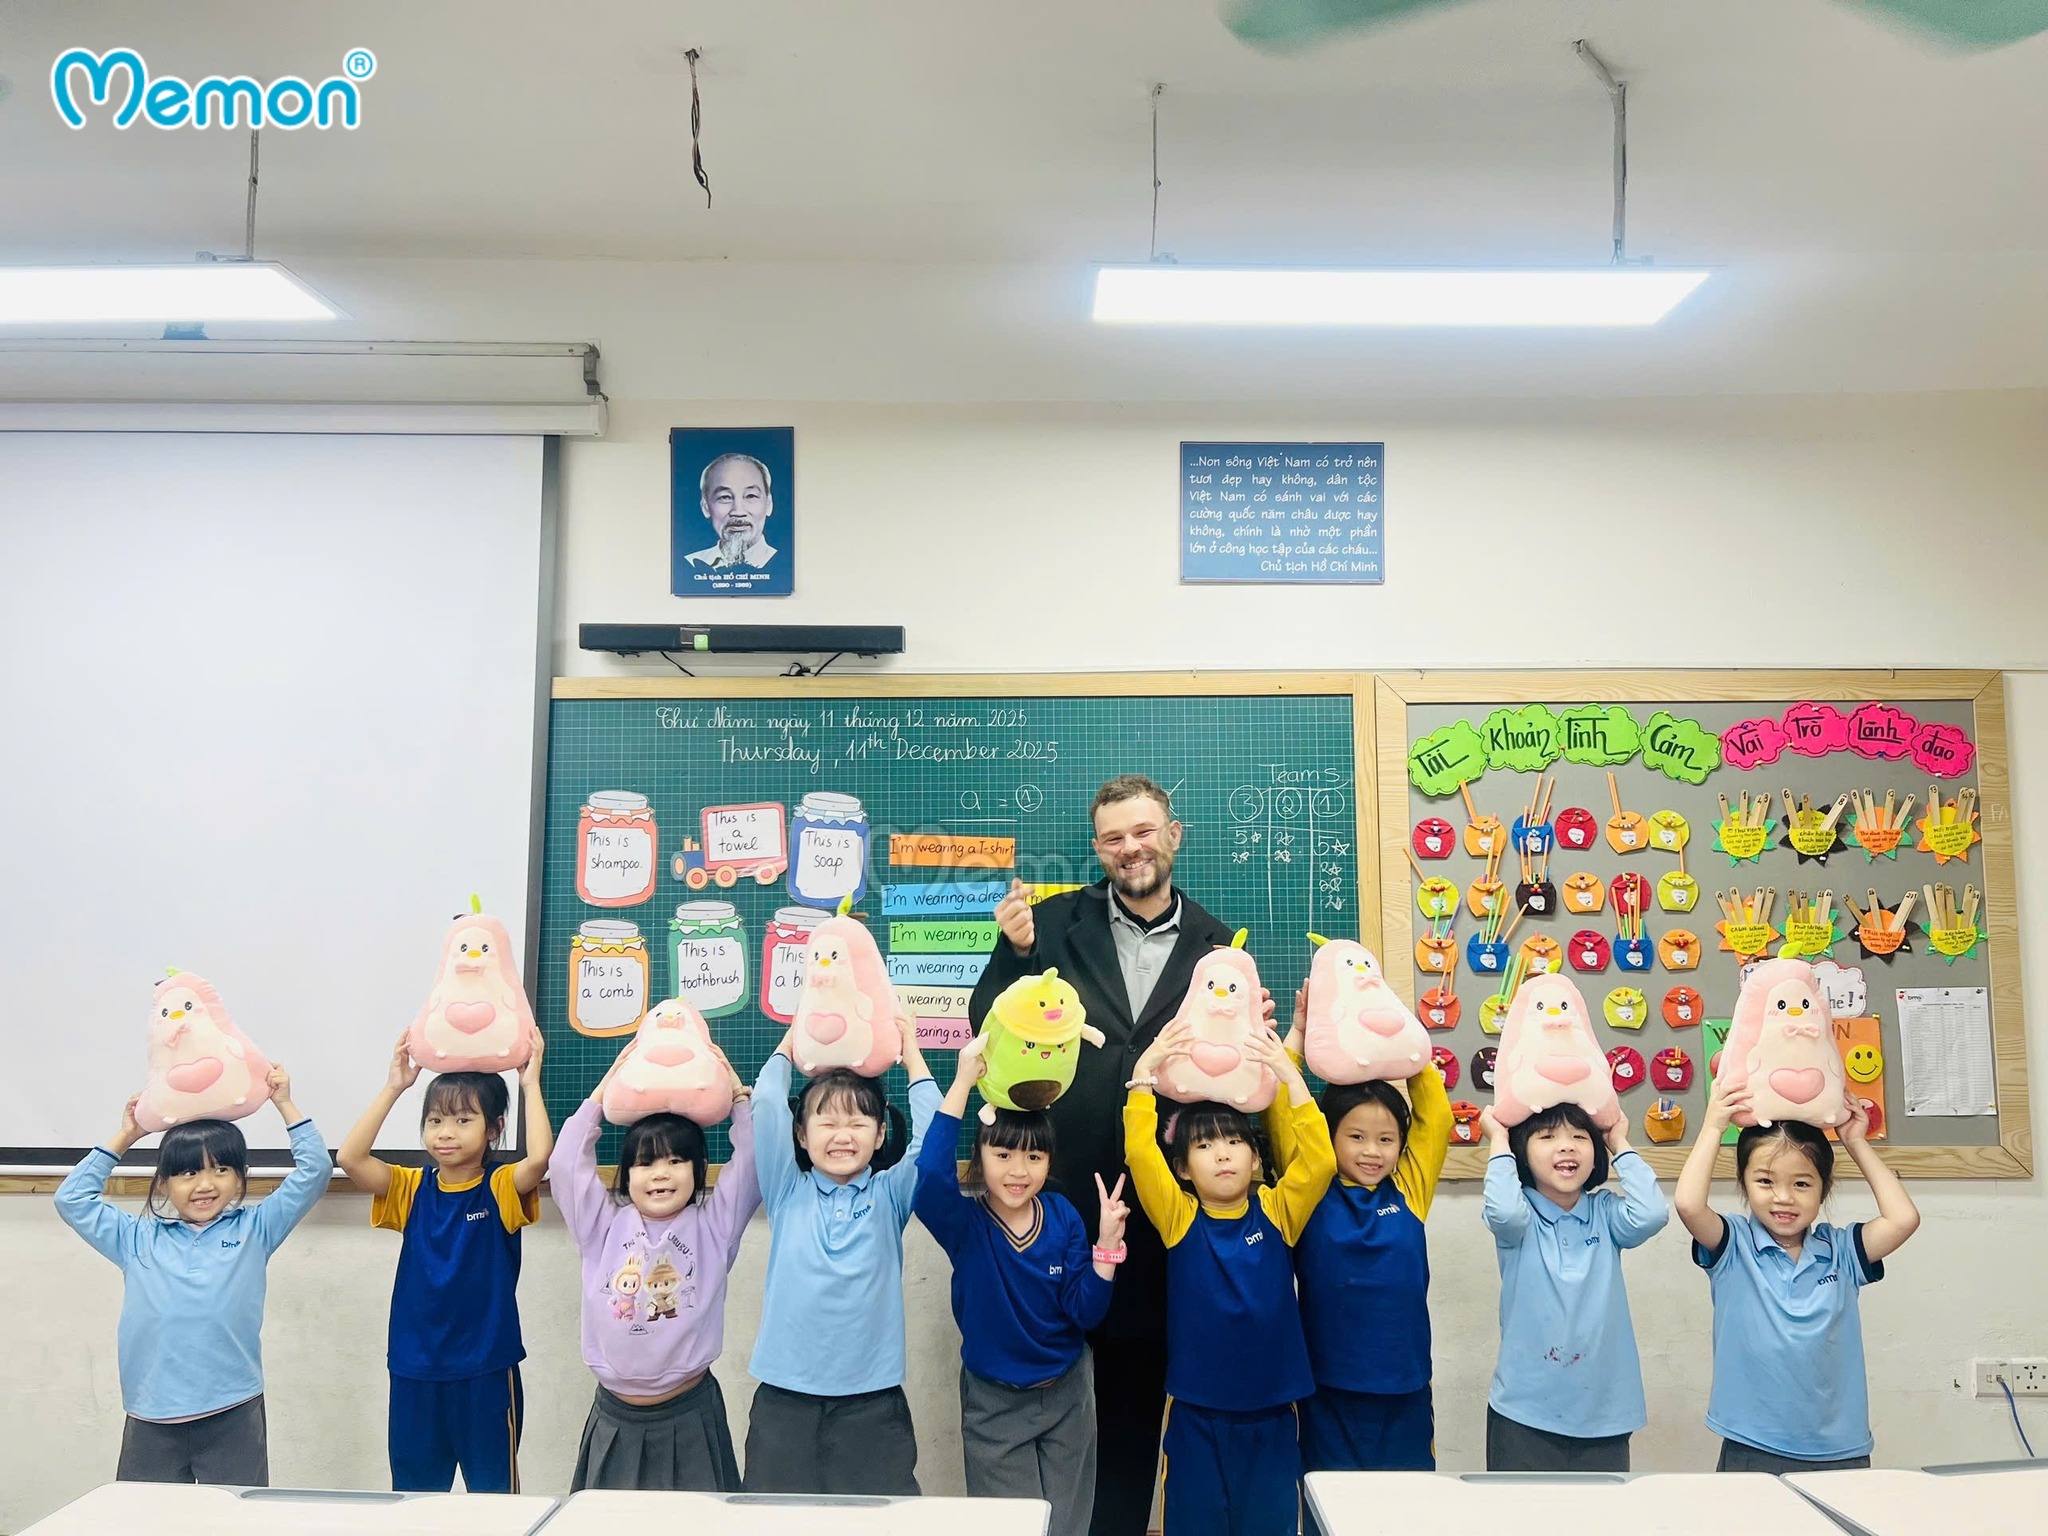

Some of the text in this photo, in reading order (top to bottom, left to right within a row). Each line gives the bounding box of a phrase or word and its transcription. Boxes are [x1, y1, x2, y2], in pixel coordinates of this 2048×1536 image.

[1225, 457, 1252, 469] sông
[1257, 456, 1280, 467] Việt
[1285, 457, 1310, 467] Nam
[1316, 456, 1329, 467] có
[1334, 455, 1353, 467] trở
[1357, 457, 1377, 467] nên
[1190, 474, 1377, 487] tươi đẹp hay không, dân tộc
[1190, 490, 1377, 503] Việt Nam có sánh vai với các
[1190, 505, 1377, 522] cường quốc năm châu được hay
[1190, 524, 1377, 540] không, chính là nhờ một phần
[1190, 543, 1206, 553] lớn
[1209, 540, 1216, 553] ở
[1219, 543, 1245, 556] công
[1249, 543, 1268, 555] học
[1272, 543, 1292, 557] tập
[1295, 542, 1315, 554] của
[1319, 543, 1338, 554] các
[1261, 558, 1377, 573] Chủ tịch Hồ Chí Minh
[707, 706, 757, 729] Năm
[767, 713, 812, 740] ngày
[819, 709, 834, 728] 11
[844, 705, 900, 741] tháng
[906, 708, 925, 727] 12
[934, 713, 980, 728] năm
[987, 708, 1028, 728] 2025
[896, 737, 1000, 762] December
[1007, 739, 1059, 763] 2025
[712, 811, 757, 826] This is
[587, 832, 630, 847] This is
[732, 829, 743, 839] a
[805, 831, 851, 849] This is
[718, 837, 759, 852] towel
[890, 836, 1014, 859] I'm wearing a T-shirt
[882, 882, 907, 909] I'm
[913, 892, 964, 911] wearing
[966, 895, 976, 904] a
[891, 923, 992, 948] I'm wearing a
[682, 942, 726, 958] This is
[582, 960, 623, 978] This is
[700, 962, 710, 972] a
[886, 956, 978, 978] I'm wearing a
[775, 975, 787, 988] a
[582, 987, 593, 999] a
[907, 994, 966, 1012] wearing a
[915, 1026, 950, 1044] earing
[952, 1029, 961, 1039] a
